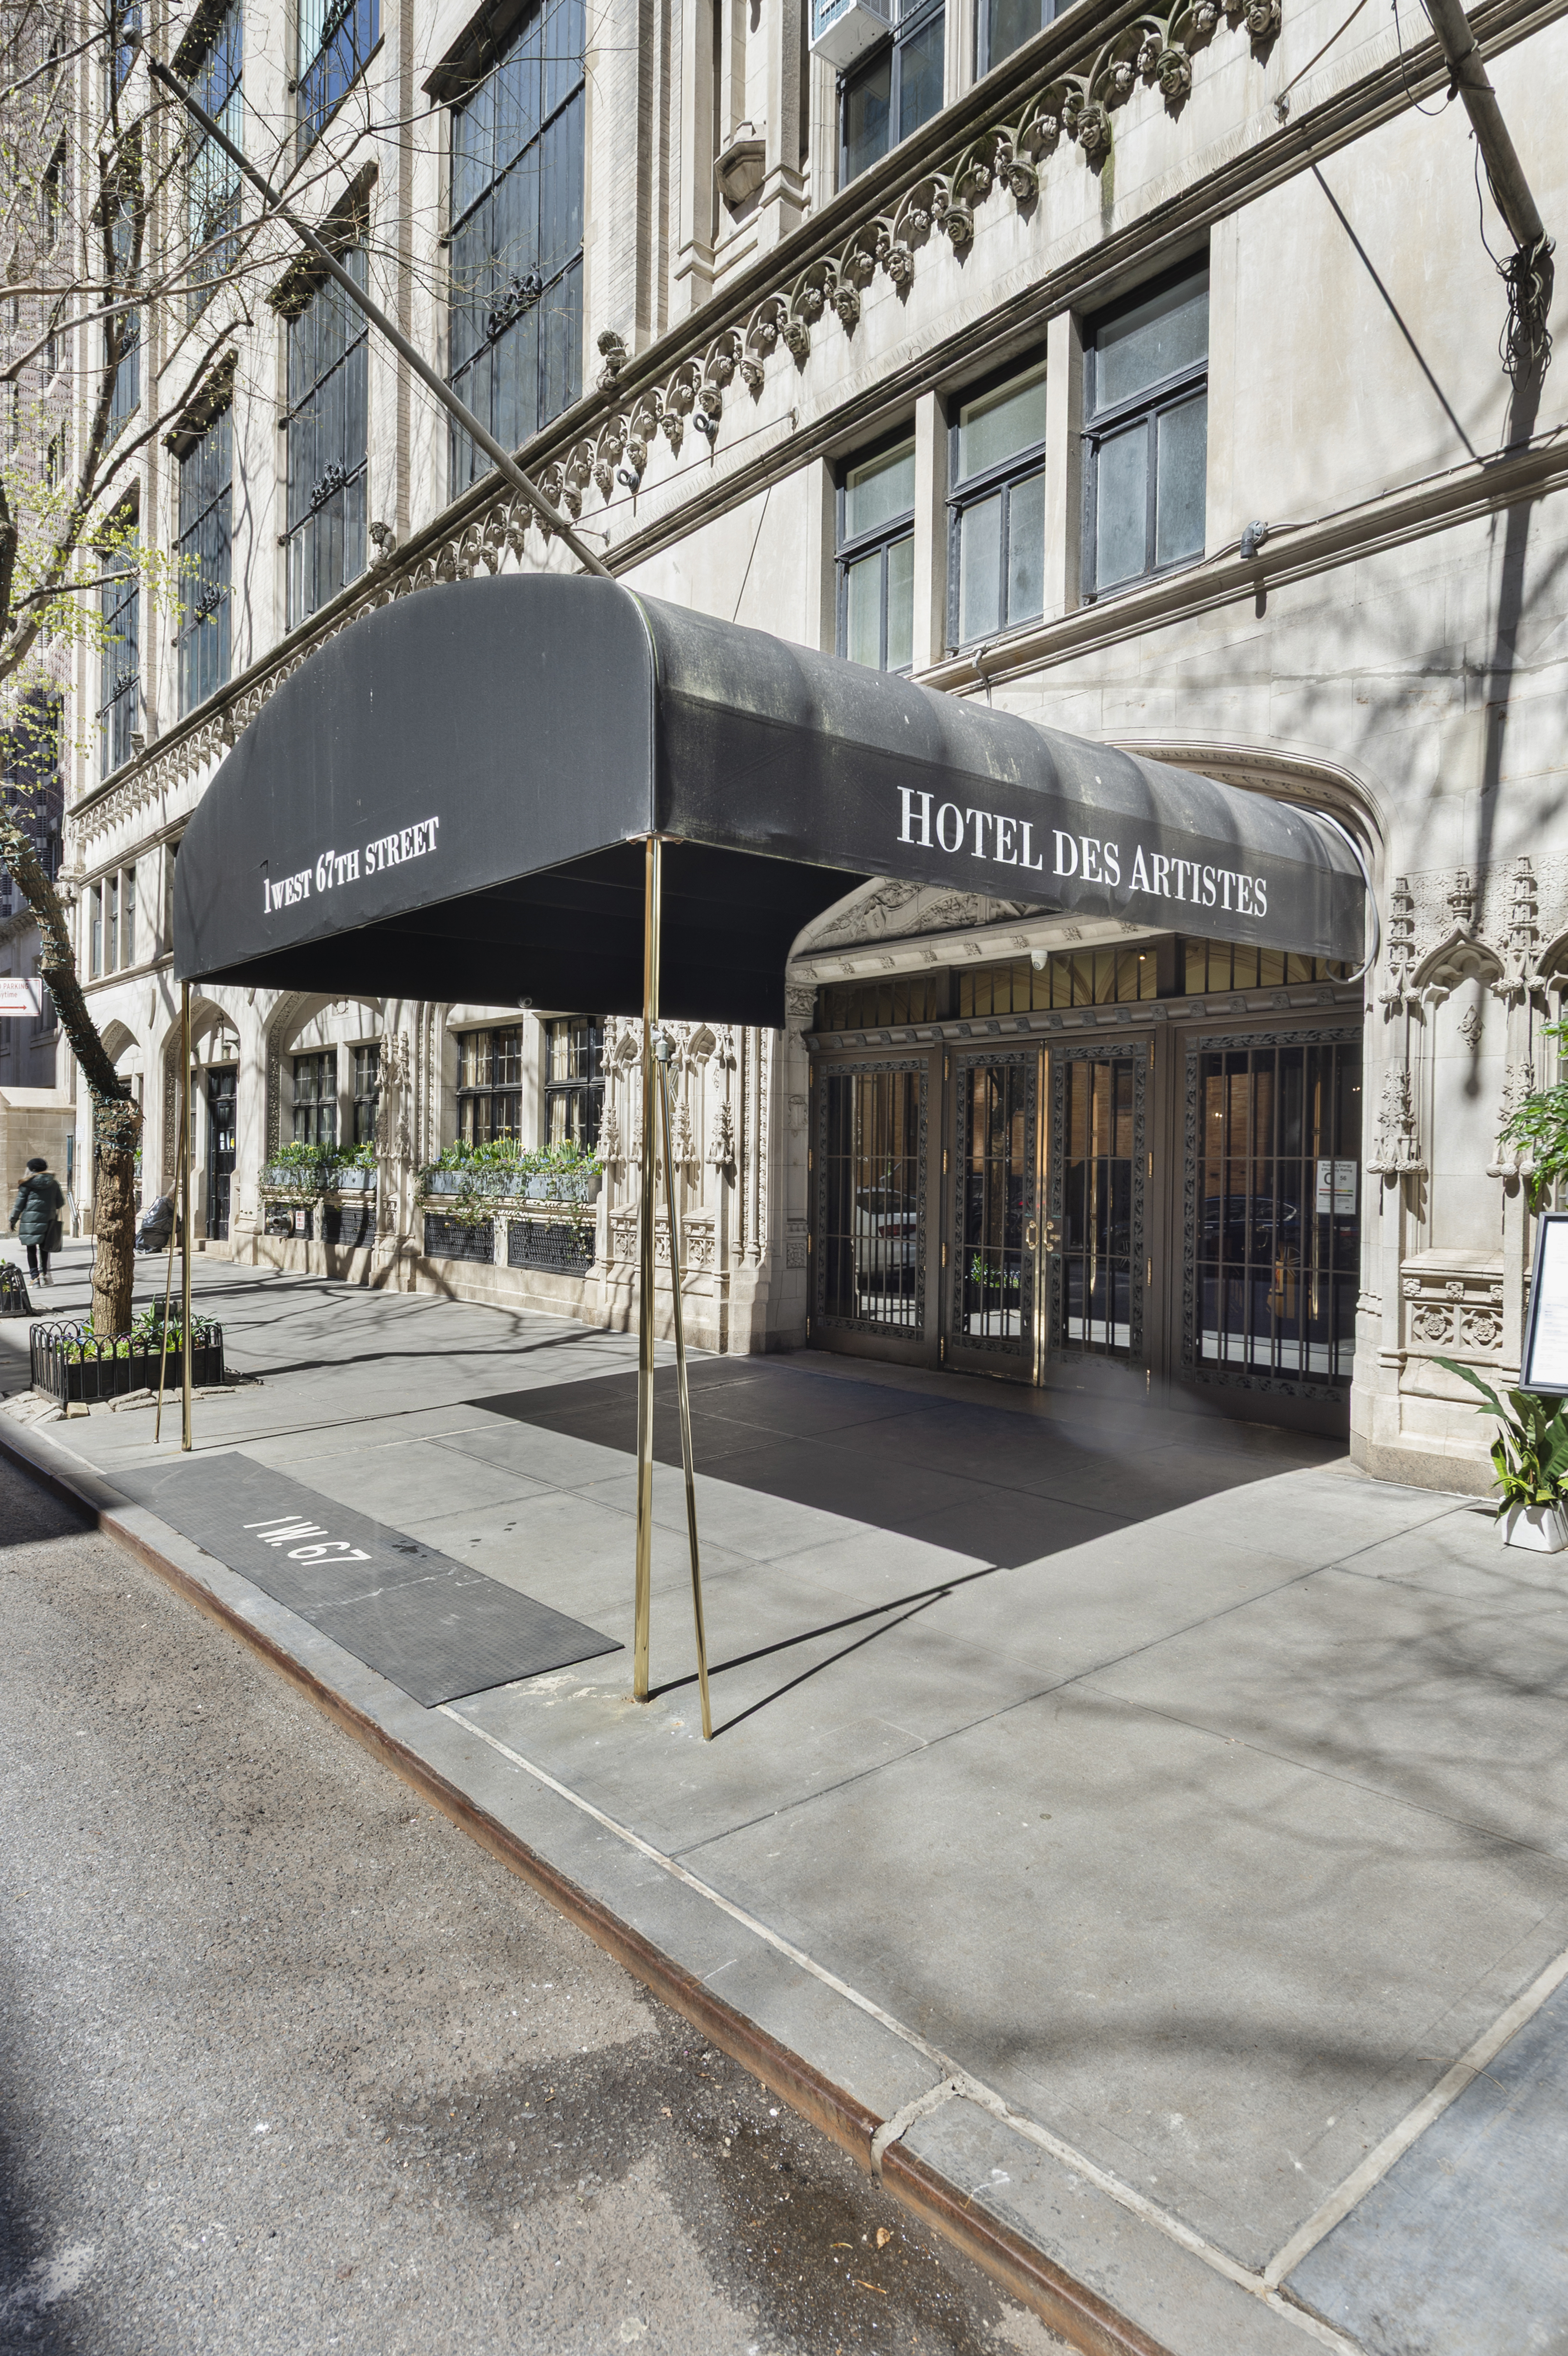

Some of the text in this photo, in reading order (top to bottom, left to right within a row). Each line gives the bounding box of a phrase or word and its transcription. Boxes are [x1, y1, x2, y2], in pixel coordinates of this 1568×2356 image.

[316, 849, 360, 893] 67TH
[365, 816, 439, 875] STREET
[896, 785, 1268, 918] HOTEL DES ARTISTES
[0, 991, 18, 999] ytime
[242, 1516, 373, 1566] 1 W. 67
